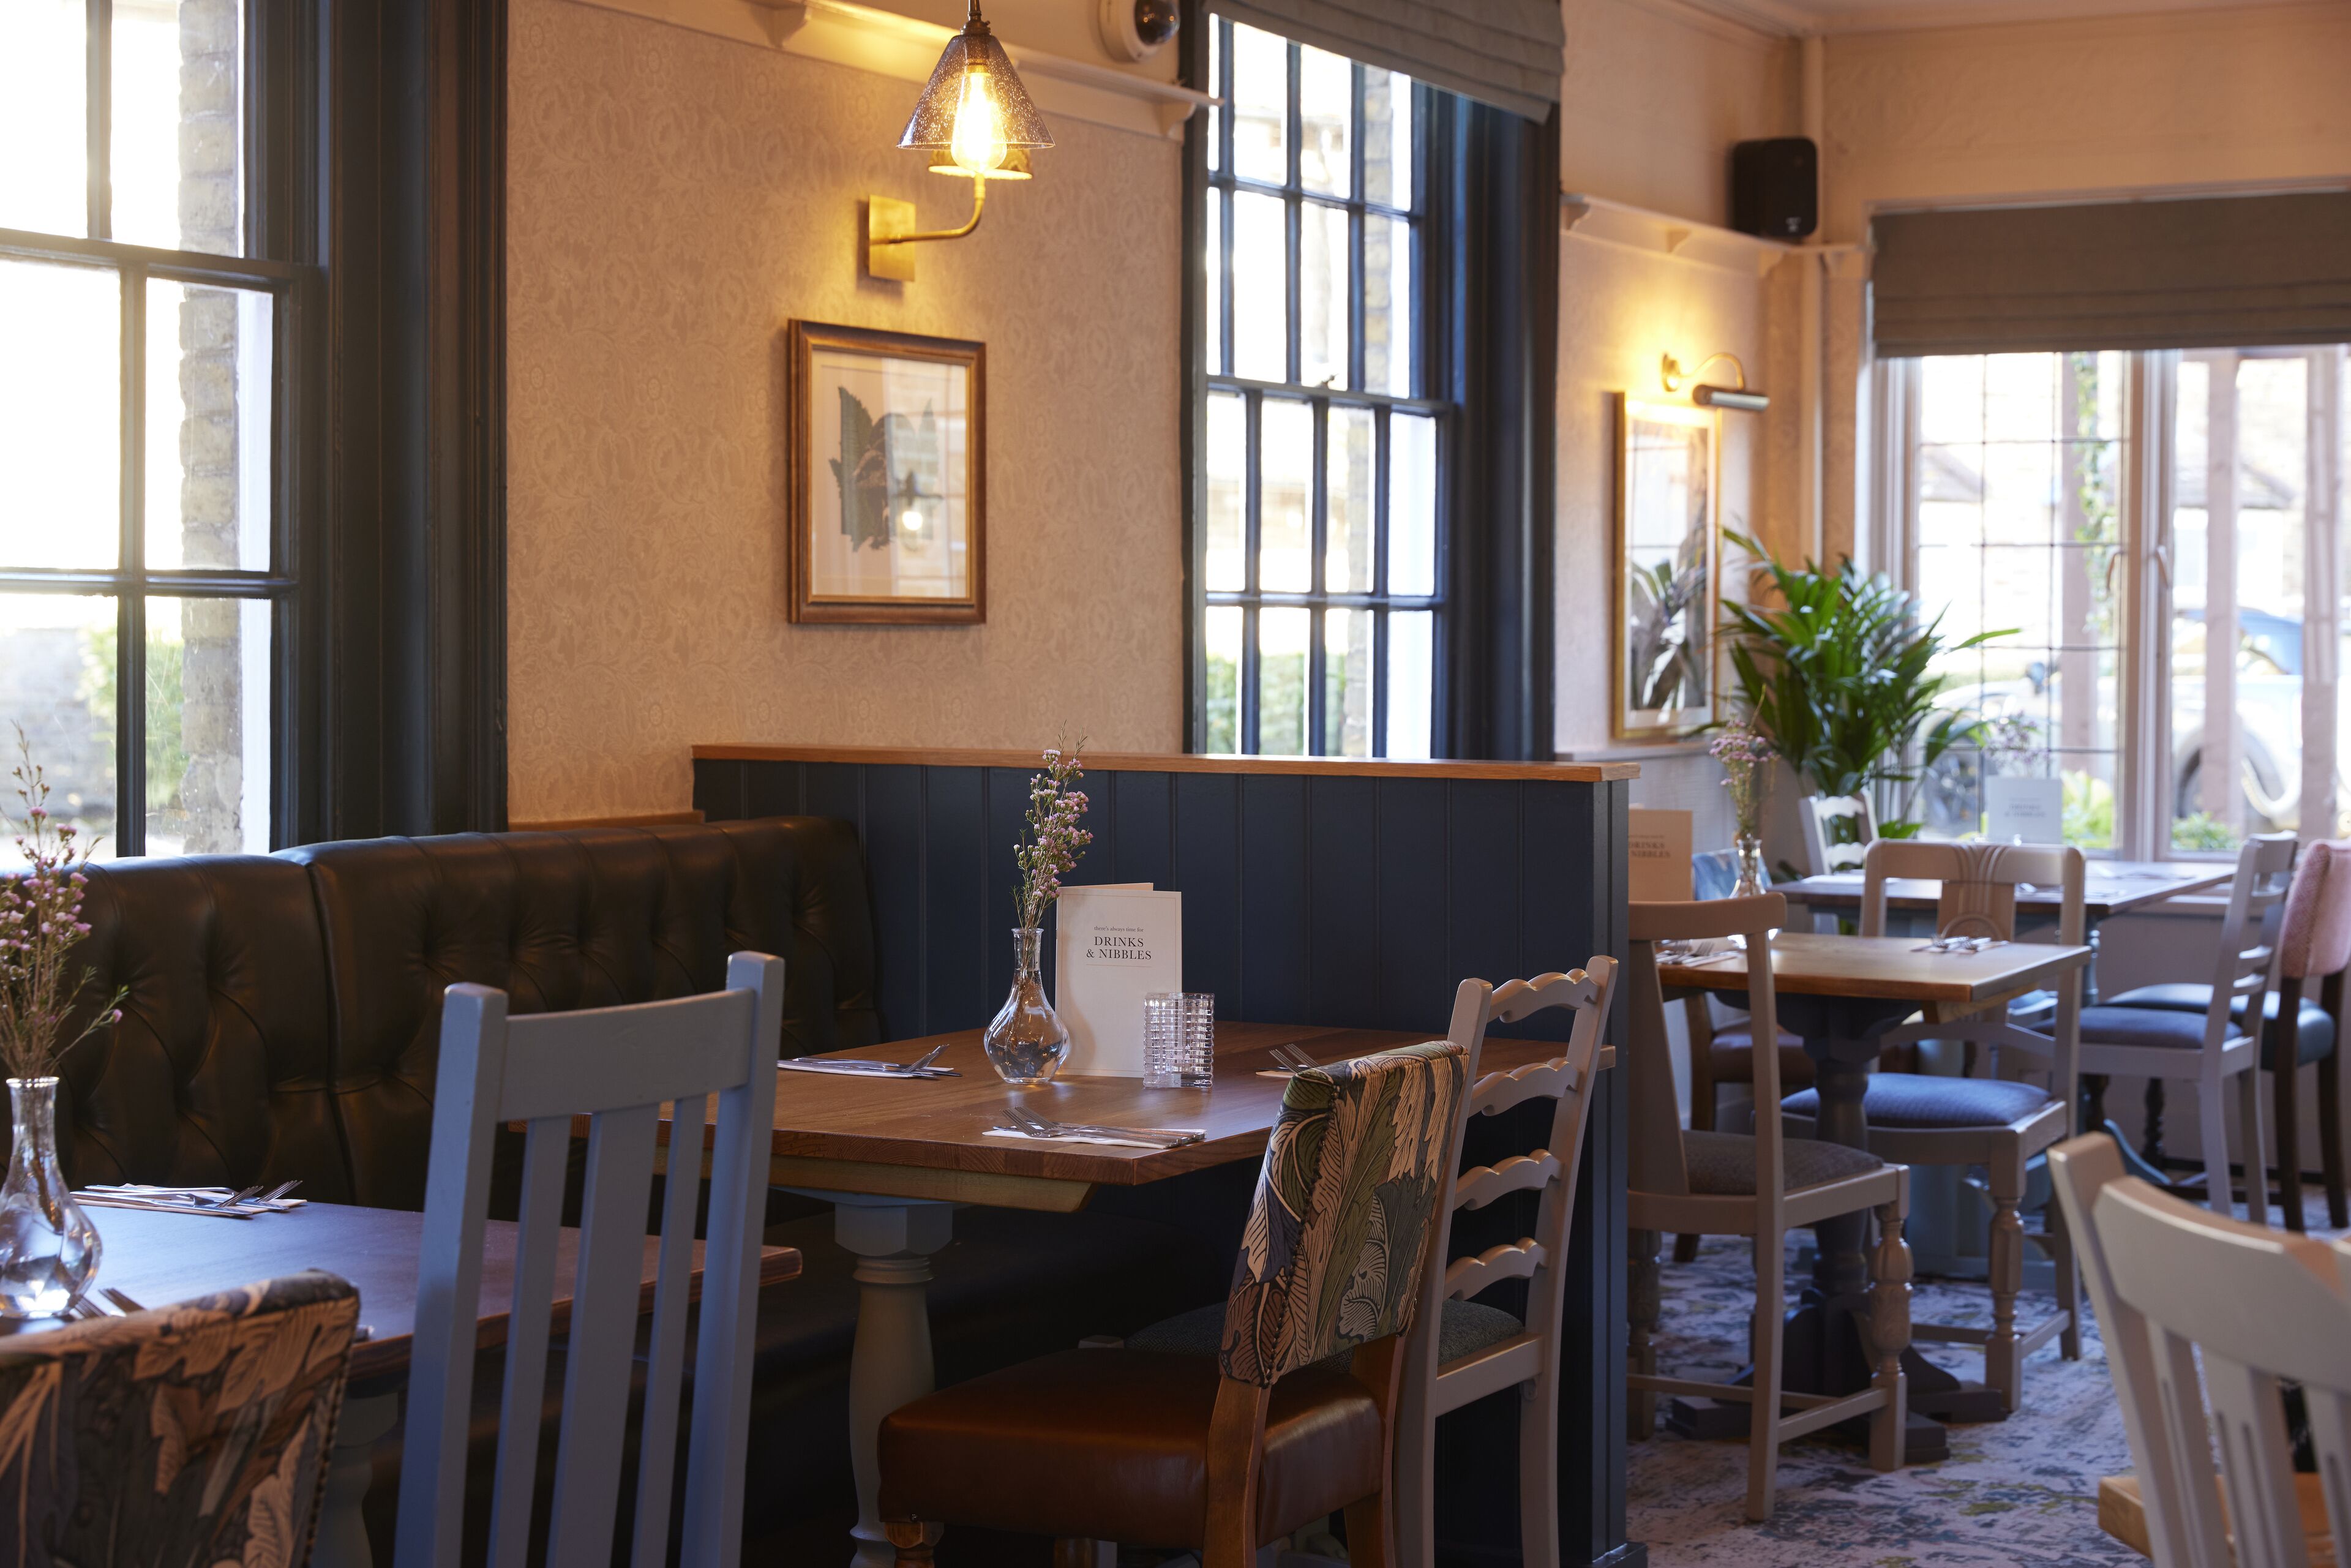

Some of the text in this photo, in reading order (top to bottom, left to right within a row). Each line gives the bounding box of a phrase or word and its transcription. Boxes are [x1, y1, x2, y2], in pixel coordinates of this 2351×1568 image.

[1094, 936, 1144, 947] DRINKS
[1086, 948, 1152, 960] & NIBBLES
